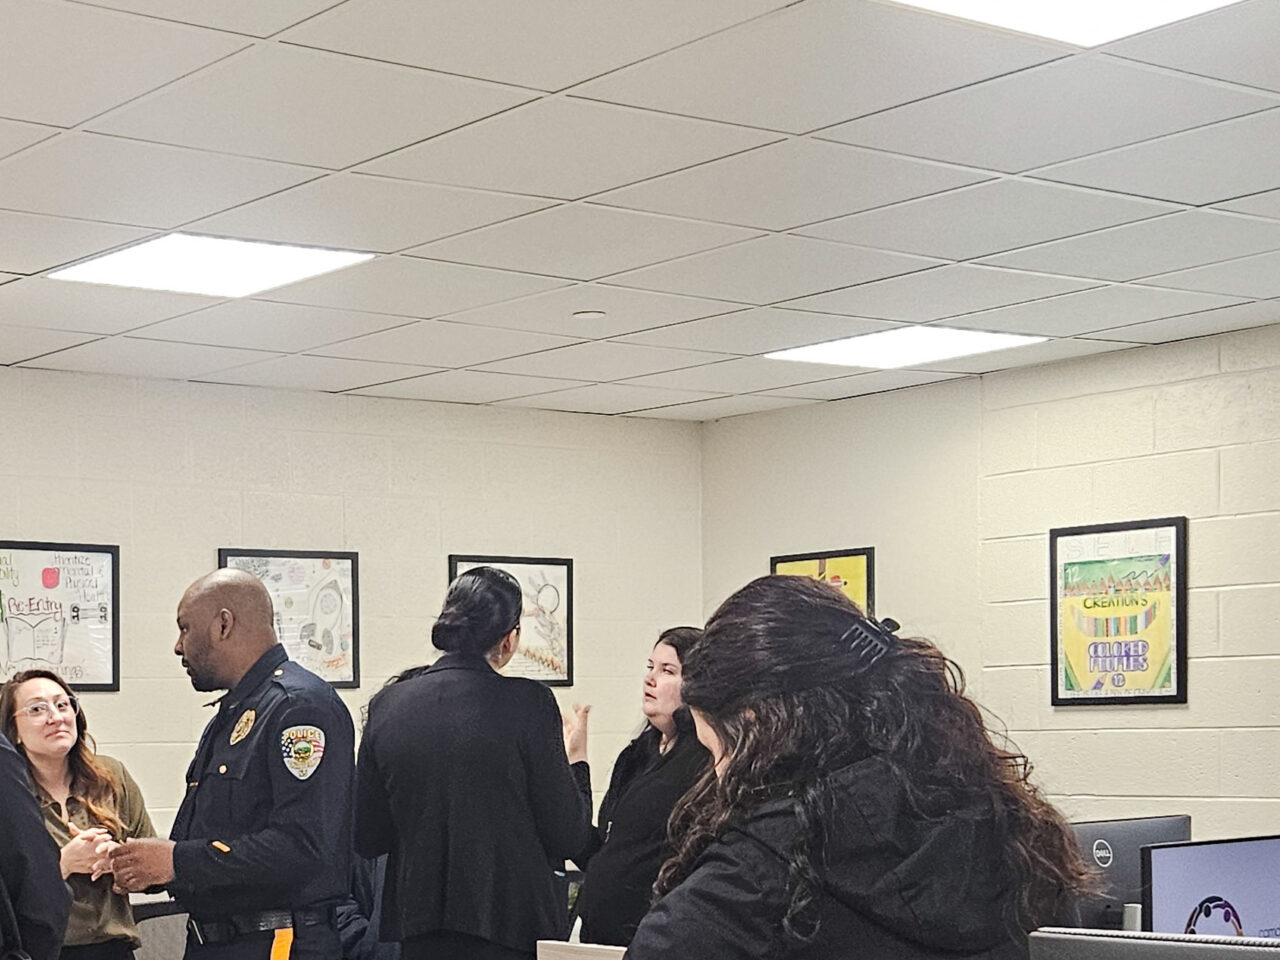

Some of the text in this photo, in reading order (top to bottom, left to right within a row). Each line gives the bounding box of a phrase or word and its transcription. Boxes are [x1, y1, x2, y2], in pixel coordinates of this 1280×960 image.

[1066, 566, 1081, 583] 12
[7, 596, 63, 622] Re-Entry
[1083, 593, 1149, 609] CREATIONS
[1088, 640, 1149, 657] COLORED
[283, 728, 321, 742] POLICE
